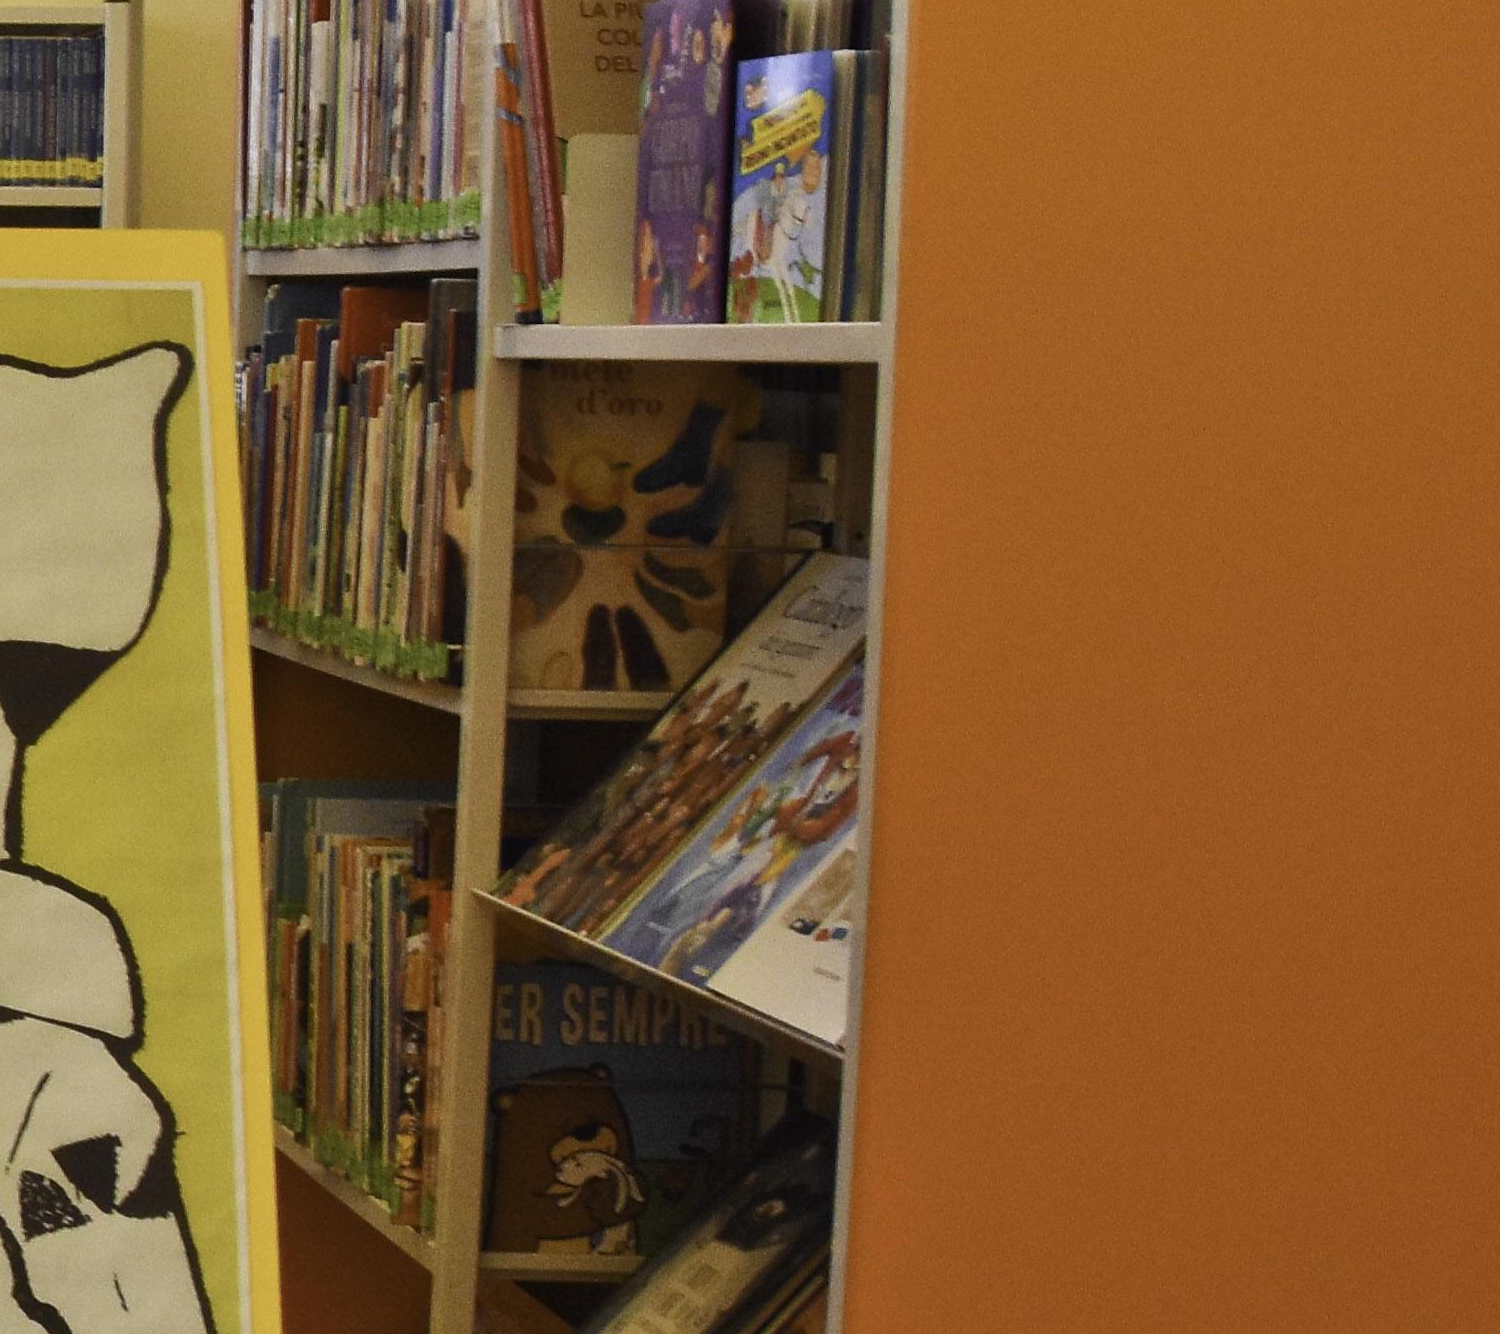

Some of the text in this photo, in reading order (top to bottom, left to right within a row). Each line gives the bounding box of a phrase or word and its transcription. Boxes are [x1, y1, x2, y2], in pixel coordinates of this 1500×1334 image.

[579, 1, 609, 18] LA
[576, 387, 664, 417] d'oro
[494, 985, 544, 1043] ER
